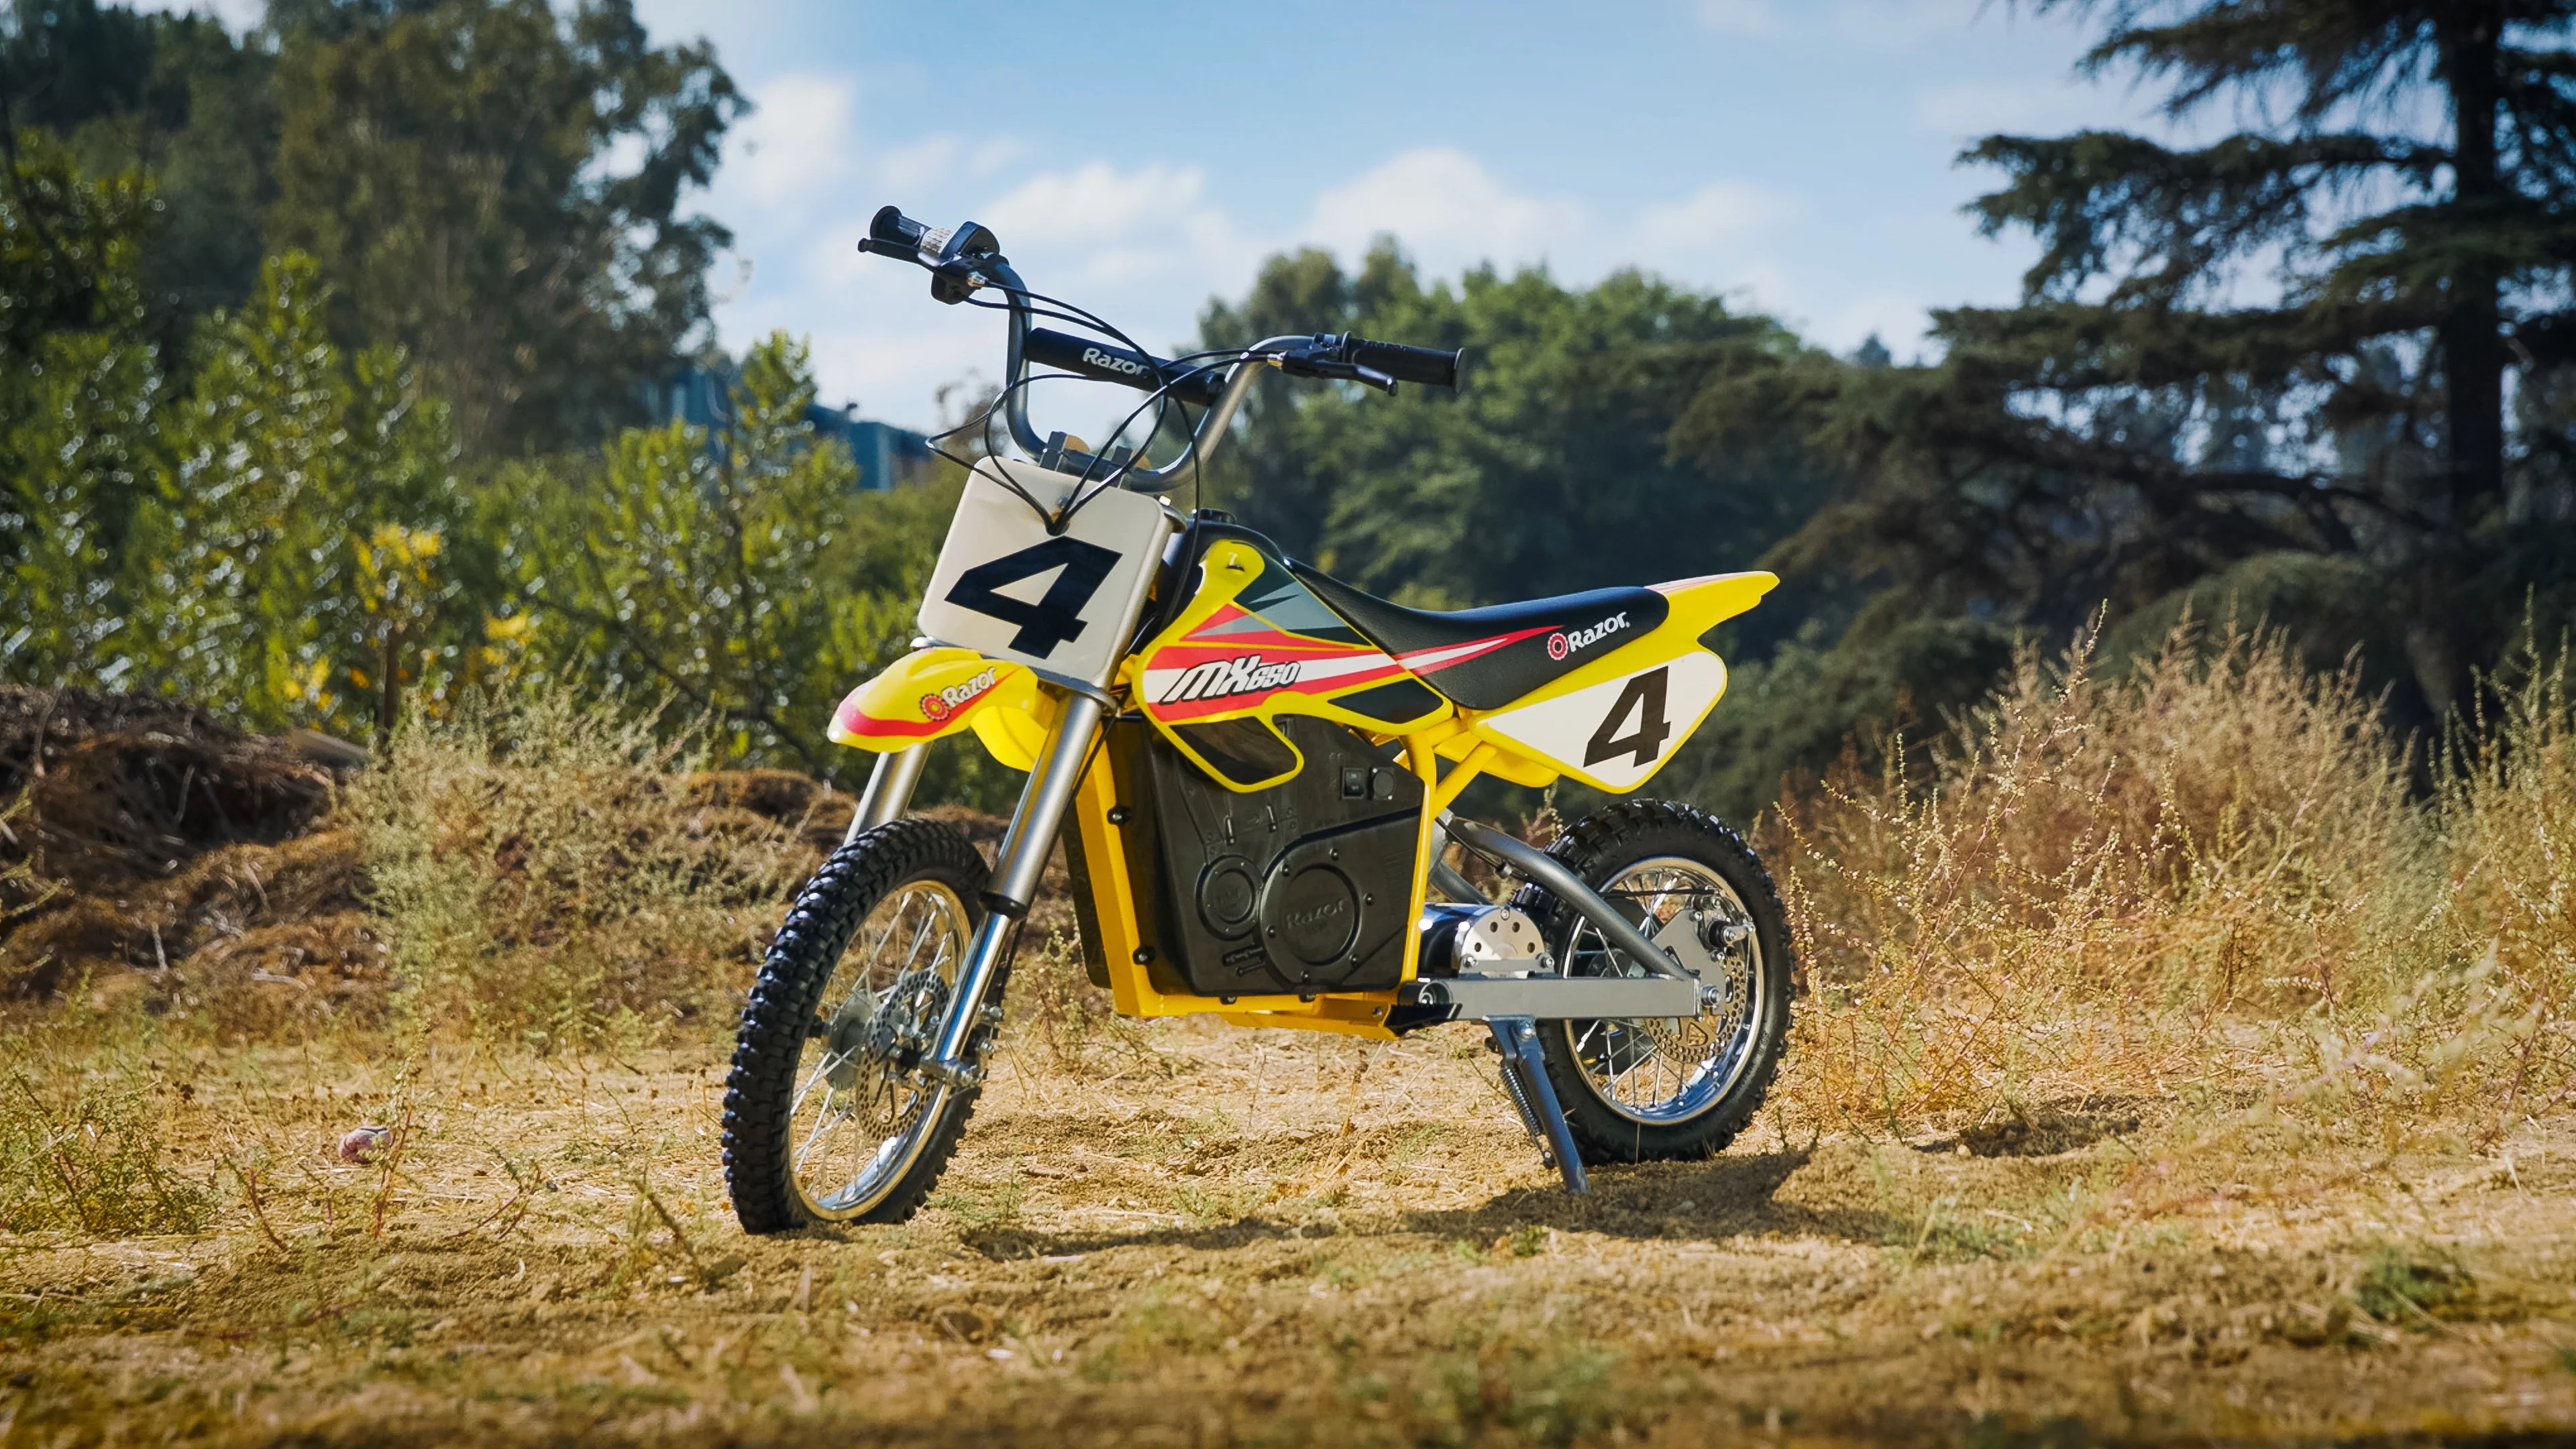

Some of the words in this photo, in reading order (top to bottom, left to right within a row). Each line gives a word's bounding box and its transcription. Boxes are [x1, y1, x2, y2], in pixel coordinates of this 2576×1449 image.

[1083, 347, 1150, 375] Razor
[944, 535, 1123, 659] 4
[1568, 611, 1627, 652] Razor
[941, 666, 996, 708] Razor
[1583, 665, 1671, 768] 4
[1285, 898, 1349, 930] Razor
